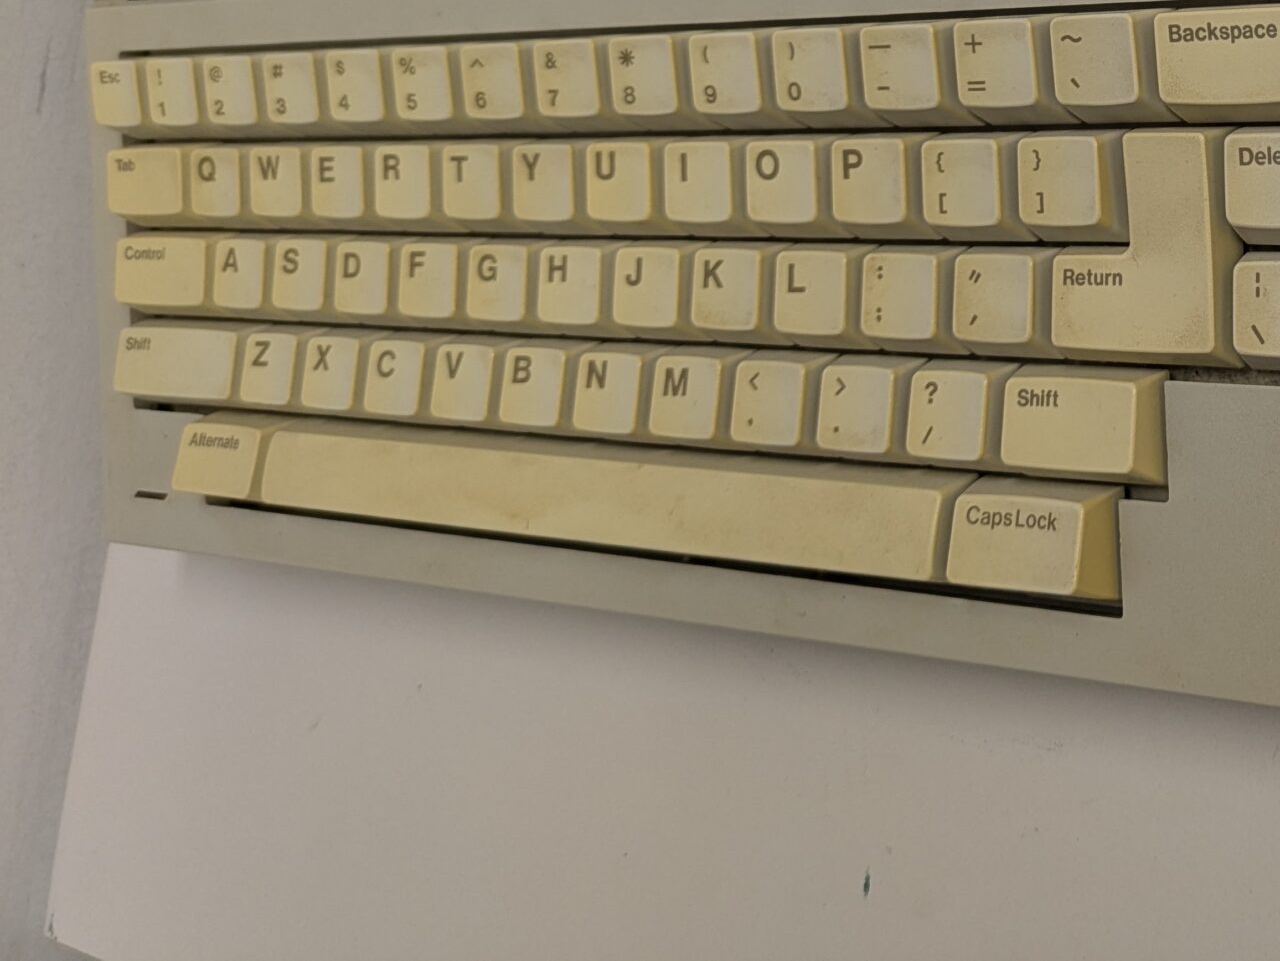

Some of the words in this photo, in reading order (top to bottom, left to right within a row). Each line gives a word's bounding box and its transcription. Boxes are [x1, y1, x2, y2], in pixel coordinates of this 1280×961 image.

[963, 33, 983, 54] +
[1167, 21, 1278, 44] Backspace
[544, 51, 558, 70] &
[701, 44, 710, 64] (
[787, 41, 796, 61] )
[98, 70, 121, 85] Esc
[207, 65, 223, 84] @
[271, 63, 284, 79] #
[333, 59, 346, 76] $
[397, 56, 417, 76] %
[337, 94, 351, 111] 4
[405, 92, 418, 111] 5
[473, 91, 487, 110] 6
[546, 88, 560, 108] 7
[622, 85, 637, 106] 8
[703, 84, 718, 105] 9
[786, 81, 802, 102] 0
[157, 101, 167, 117] 1
[213, 99, 226, 117] 2
[274, 97, 287, 116] 3
[114, 158, 136, 172] Tab
[196, 155, 216, 183] Q
[256, 155, 280, 181] W
[317, 156, 335, 184] E
[382, 153, 400, 181] R
[449, 155, 469, 183] T
[520, 152, 541, 182] Y
[594, 150, 616, 181] U
[679, 152, 688, 183] I
[754, 148, 780, 181] O
[842, 148, 863, 180] P
[935, 151, 945, 174] {
[1032, 149, 1042, 172] }
[938, 192, 948, 215] [
[1035, 191, 1045, 214] ]
[123, 245, 166, 261] Control
[221, 247, 239, 273] A
[281, 247, 300, 275] S
[408, 250, 426, 279] F
[341, 251, 361, 279] D
[476, 253, 497, 282] G
[547, 254, 568, 283] H
[625, 256, 643, 287] J
[702, 259, 724, 289] K
[787, 262, 806, 294] L
[1062, 268, 1123, 287] Return
[125, 336, 152, 352] Shift
[1250, 324, 1266, 345] \
[251, 340, 271, 368] Z
[312, 344, 332, 371] X
[376, 349, 396, 379] C
[445, 350, 464, 380] V
[511, 355, 532, 384] B
[585, 359, 608, 390] N
[748, 371, 760, 391] <
[662, 367, 689, 397] M
[834, 376, 847, 397] >
[924, 381, 939, 405] ?
[1016, 388, 1059, 408] Shift
[187, 431, 240, 451] Alternate
[921, 425, 934, 445] /
